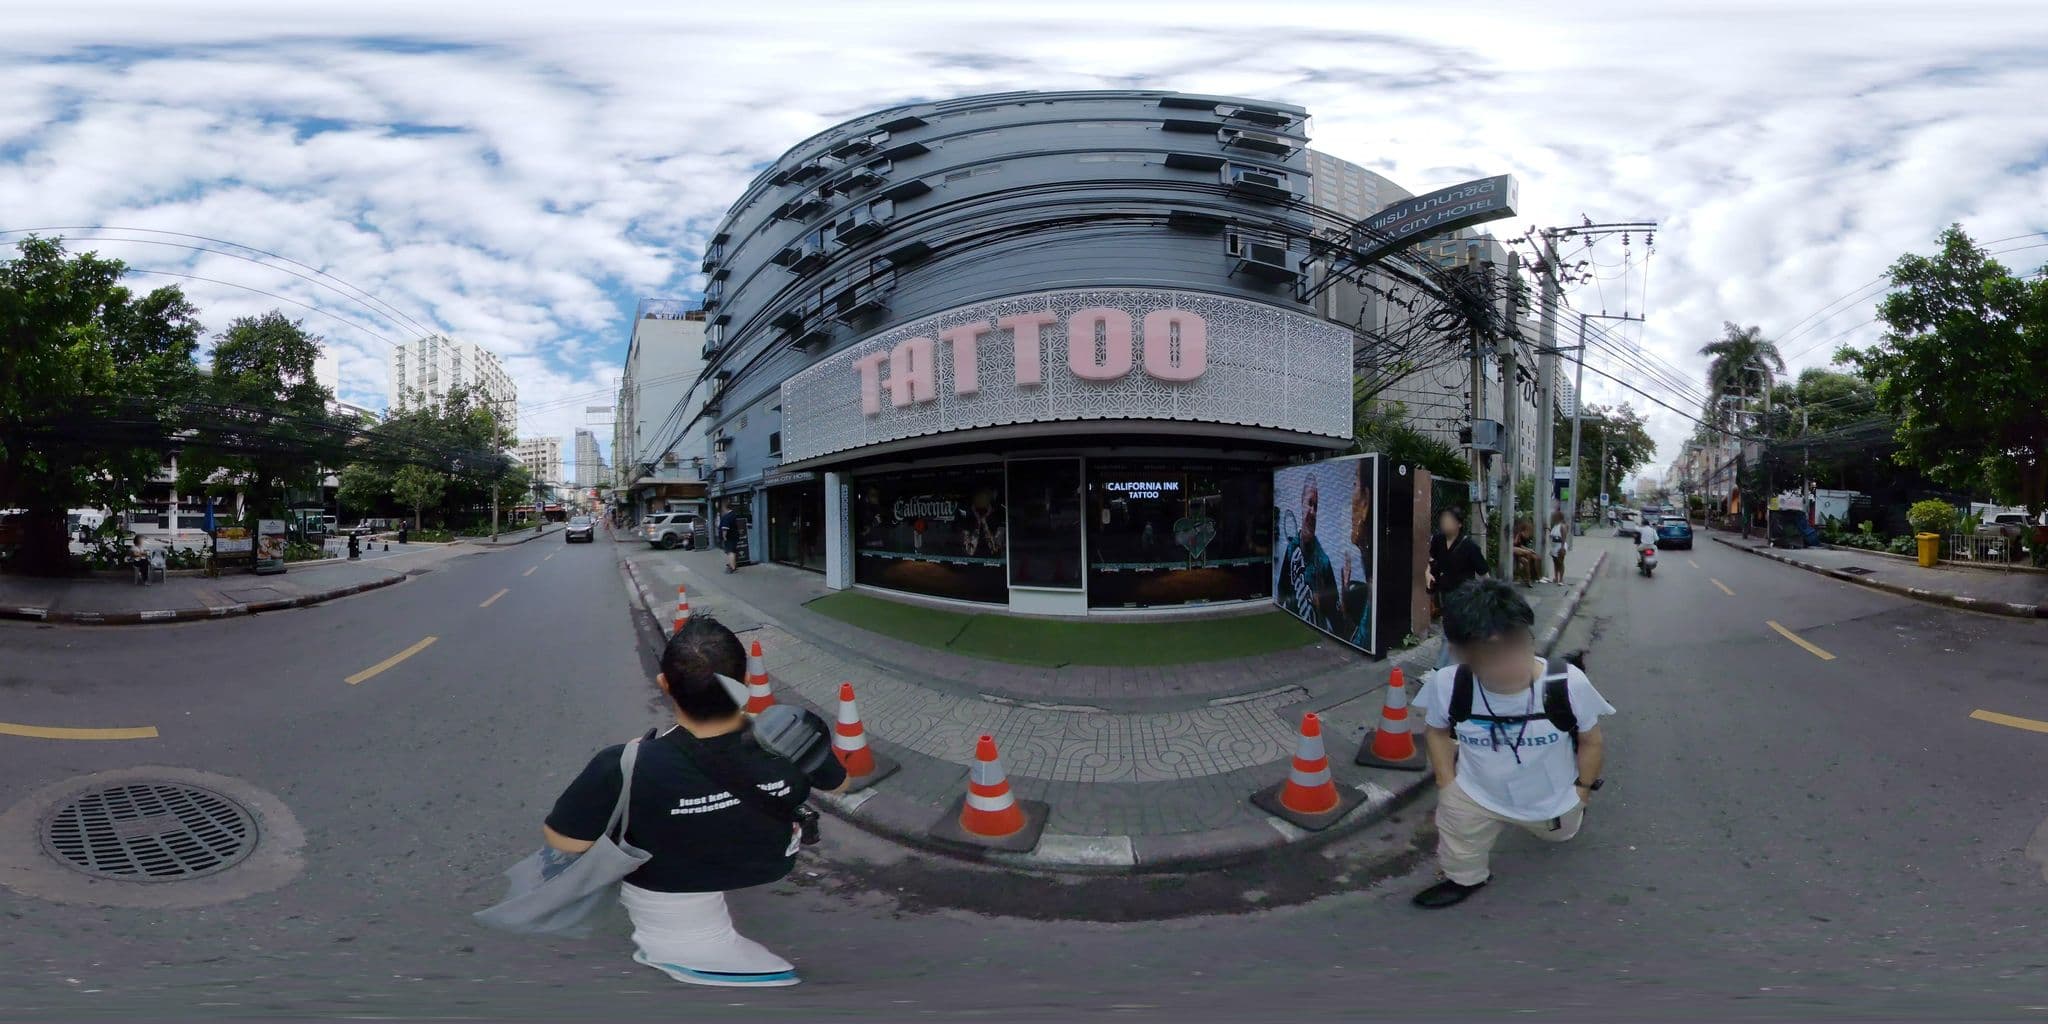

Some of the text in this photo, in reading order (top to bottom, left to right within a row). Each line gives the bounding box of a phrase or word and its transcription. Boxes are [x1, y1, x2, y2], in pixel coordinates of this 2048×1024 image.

[1358, 199, 1494, 253] NAA CITY HOTEL
[852, 307, 1208, 417] TATTOO
[1107, 482, 1179, 491] CALIFORNIA INK
[1128, 491, 1159, 499] TATTOO
[1458, 732, 1559, 747] DROEBIRD
[708, 791, 733, 803] kee
